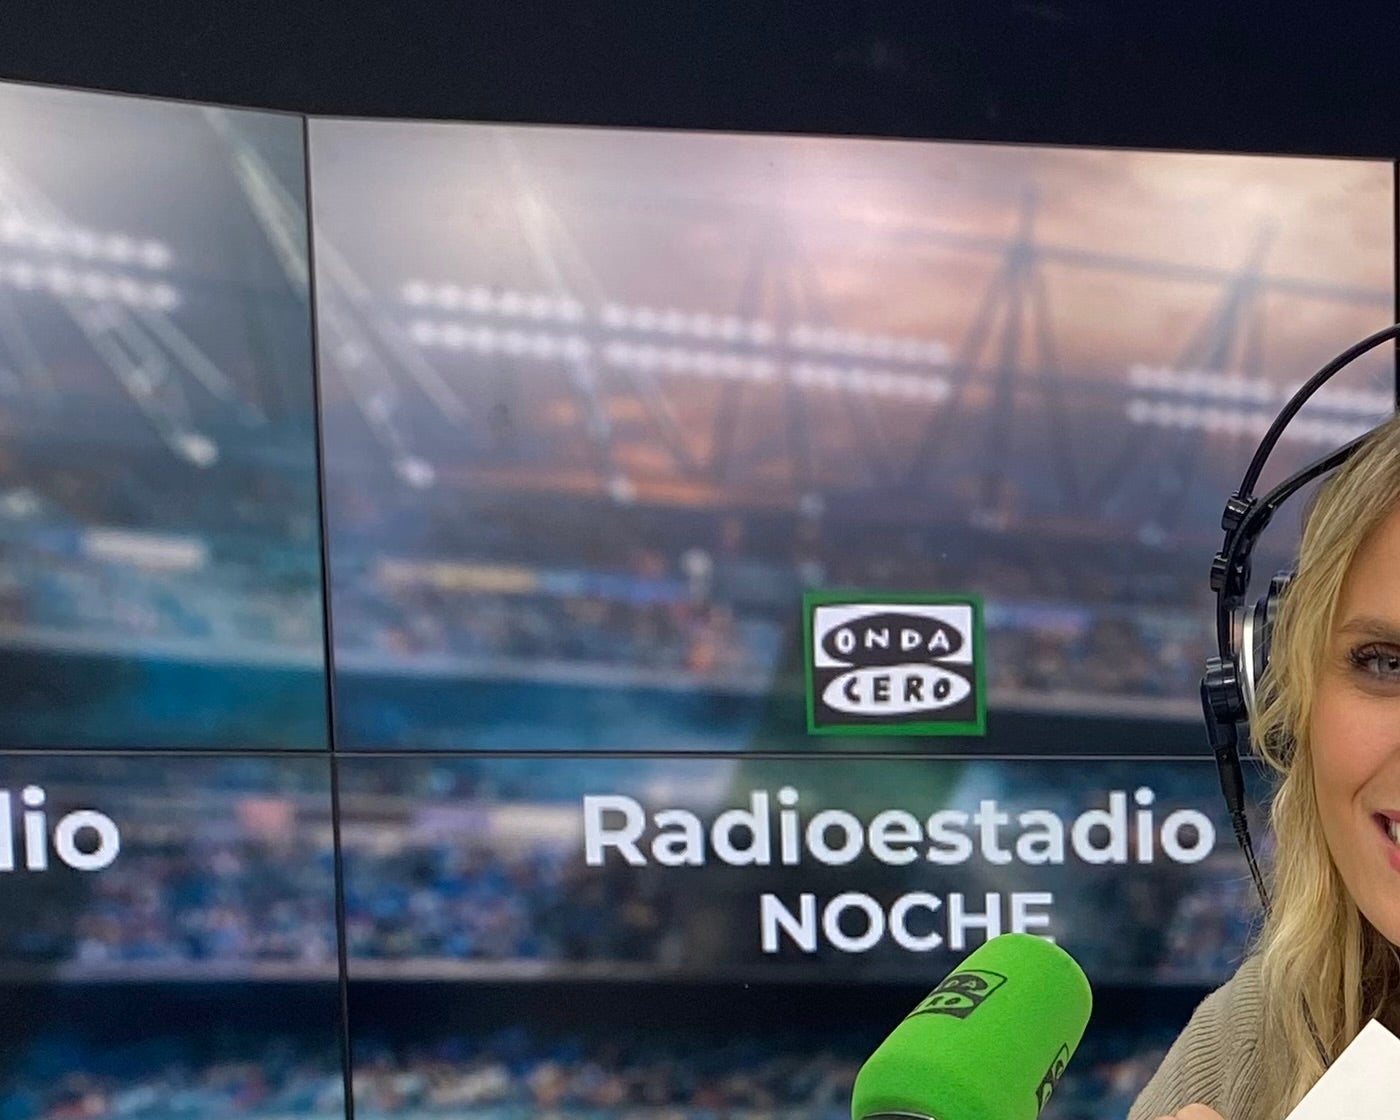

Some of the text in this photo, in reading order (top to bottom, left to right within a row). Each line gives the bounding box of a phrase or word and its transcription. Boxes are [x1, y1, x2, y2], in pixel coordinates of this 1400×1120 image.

[834, 627, 950, 654] ONDA
[843, 675, 951, 703] CERO
[0, 785, 120, 872] io
[583, 786, 1215, 867] Radioestadio
[760, 892, 1054, 953] NOCHE
